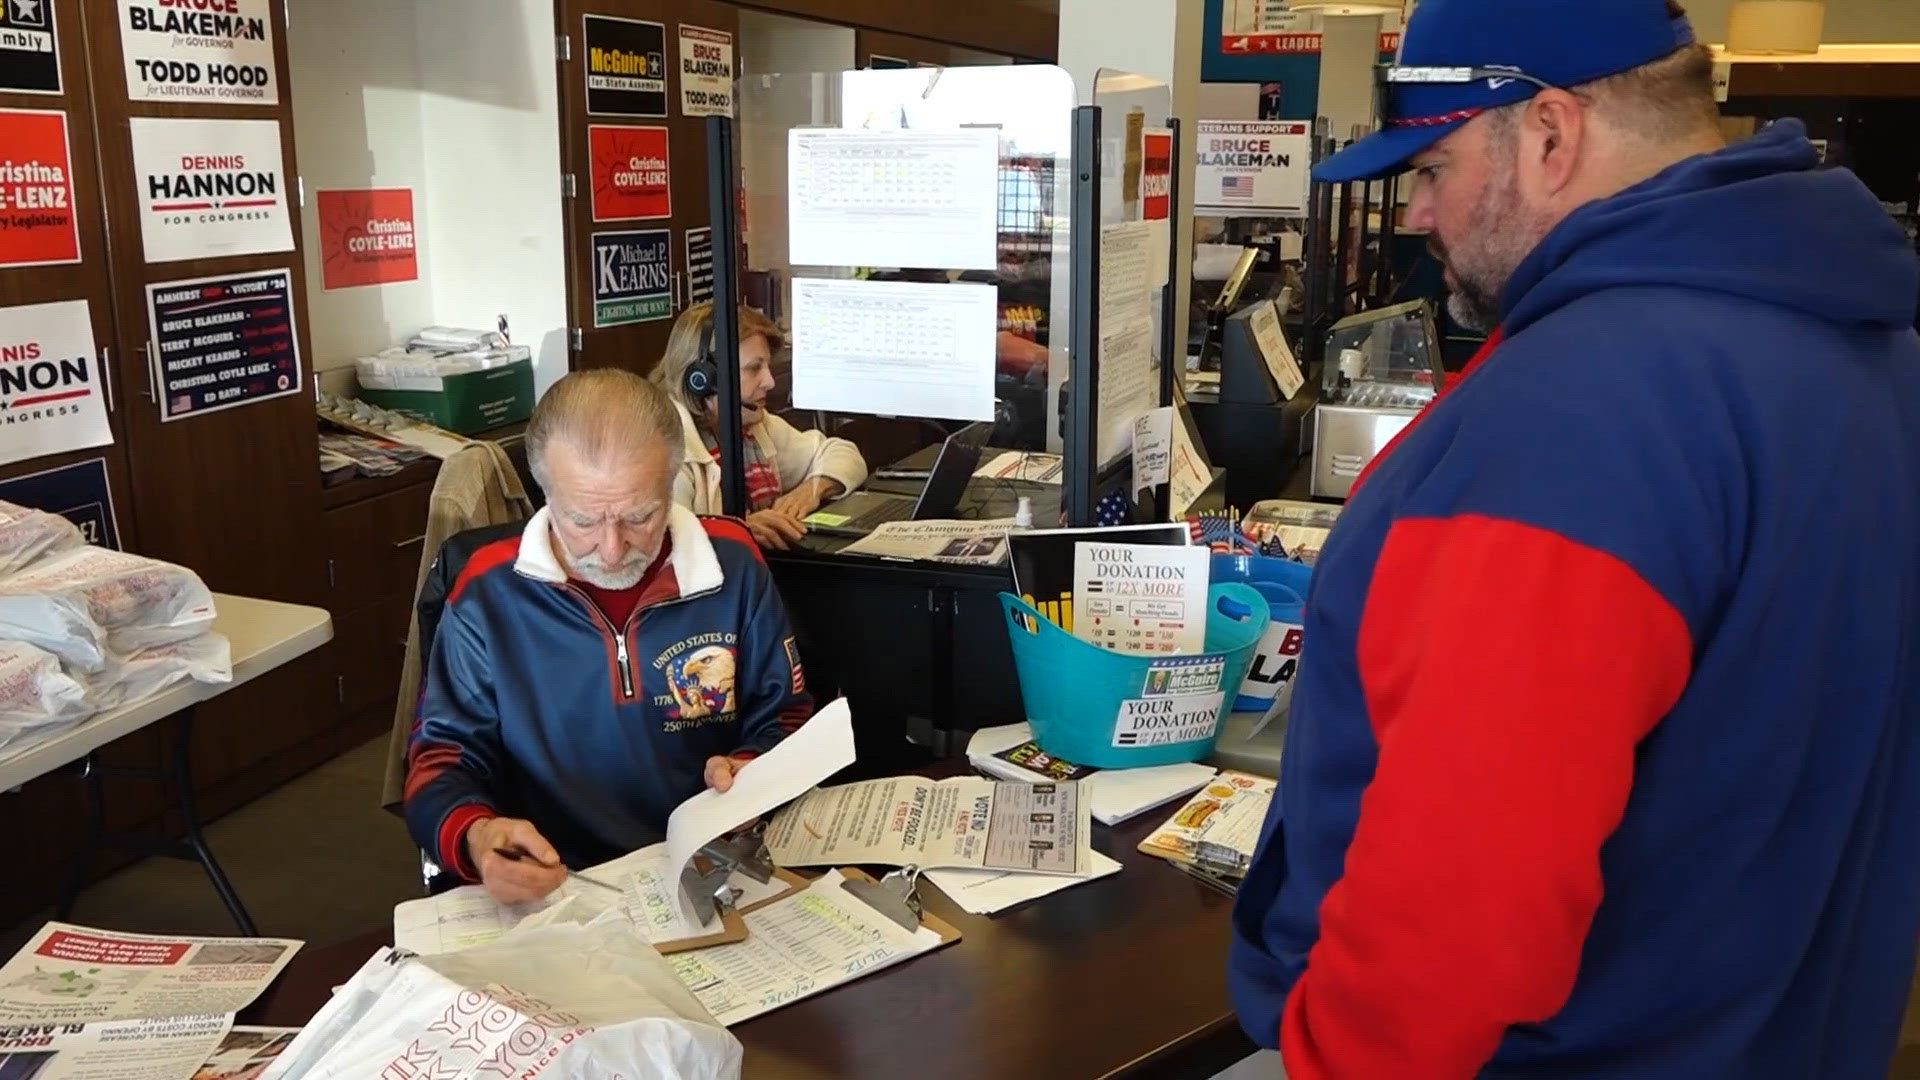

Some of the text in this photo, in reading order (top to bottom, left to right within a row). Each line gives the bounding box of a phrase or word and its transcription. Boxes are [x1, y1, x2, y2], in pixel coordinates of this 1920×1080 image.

[129, 6, 264, 41] BLAKEMAN
[172, 36, 234, 49] for GOVERNOR
[1275, 37, 1322, 50] LEADER
[693, 43, 721, 61] BRUCE
[590, 47, 647, 75] McGuire
[684, 59, 730, 77] BLAKEMAN
[135, 59, 268, 87] TODD HOOD
[146, 84, 264, 98] for LIEUTENANT GOVERNOR
[605, 78, 626, 88] State
[629, 80, 661, 90] Assembly
[685, 91, 707, 105] TODD
[1246, 124, 1293, 133] SUPPORT
[1210, 139, 1270, 153] BRUCE
[182, 156, 244, 170] DENNIS
[630, 157, 665, 171] Christina
[149, 172, 276, 199] HANNON
[614, 172, 667, 186] COYLE-LENZ
[164, 212, 270, 225] FOR CONGRESS
[367, 218, 412, 234] Christina
[349, 233, 414, 252] COYLE-LENZ
[620, 242, 667, 264] Michael P.
[597, 245, 669, 294] KEARNS
[156, 289, 200, 304] AMHERST
[163, 319, 192, 332] BRUCE
[195, 311, 244, 324] BLAKEMAN
[161, 338, 190, 352] TERRY
[168, 349, 241, 371] MICKEY KEARNS
[170, 373, 217, 390] CHRISTINA
[219, 367, 246, 381] COYLE
[248, 362, 270, 376] LENZ
[204, 393, 217, 403] ED
[1089, 548, 1133, 563] YOUR
[1096, 563, 1185, 579] DONATION
[1116, 582, 1139, 594] 12X
[1142, 582, 1184, 595] MORE
[653, 641, 685, 670] UNITED
[687, 632, 722, 647] STATES
[1174, 664, 1220, 674] TERRY
[1170, 673, 1218, 688] McGuire
[654, 695, 674, 706] 1776
[1128, 700, 1174, 715] YOUR
[663, 719, 695, 732] 250TH
[1132, 707, 1219, 730] DONATION
[1150, 731, 1174, 743] 12X
[1176, 723, 1214, 740] MORE
[912, 786, 927, 808] DON'T
[909, 807, 922, 818] BE
[971, 795, 990, 831] VOTE NO
[101, 1021, 224, 1035] ENERGY COSTS BY OPENING
